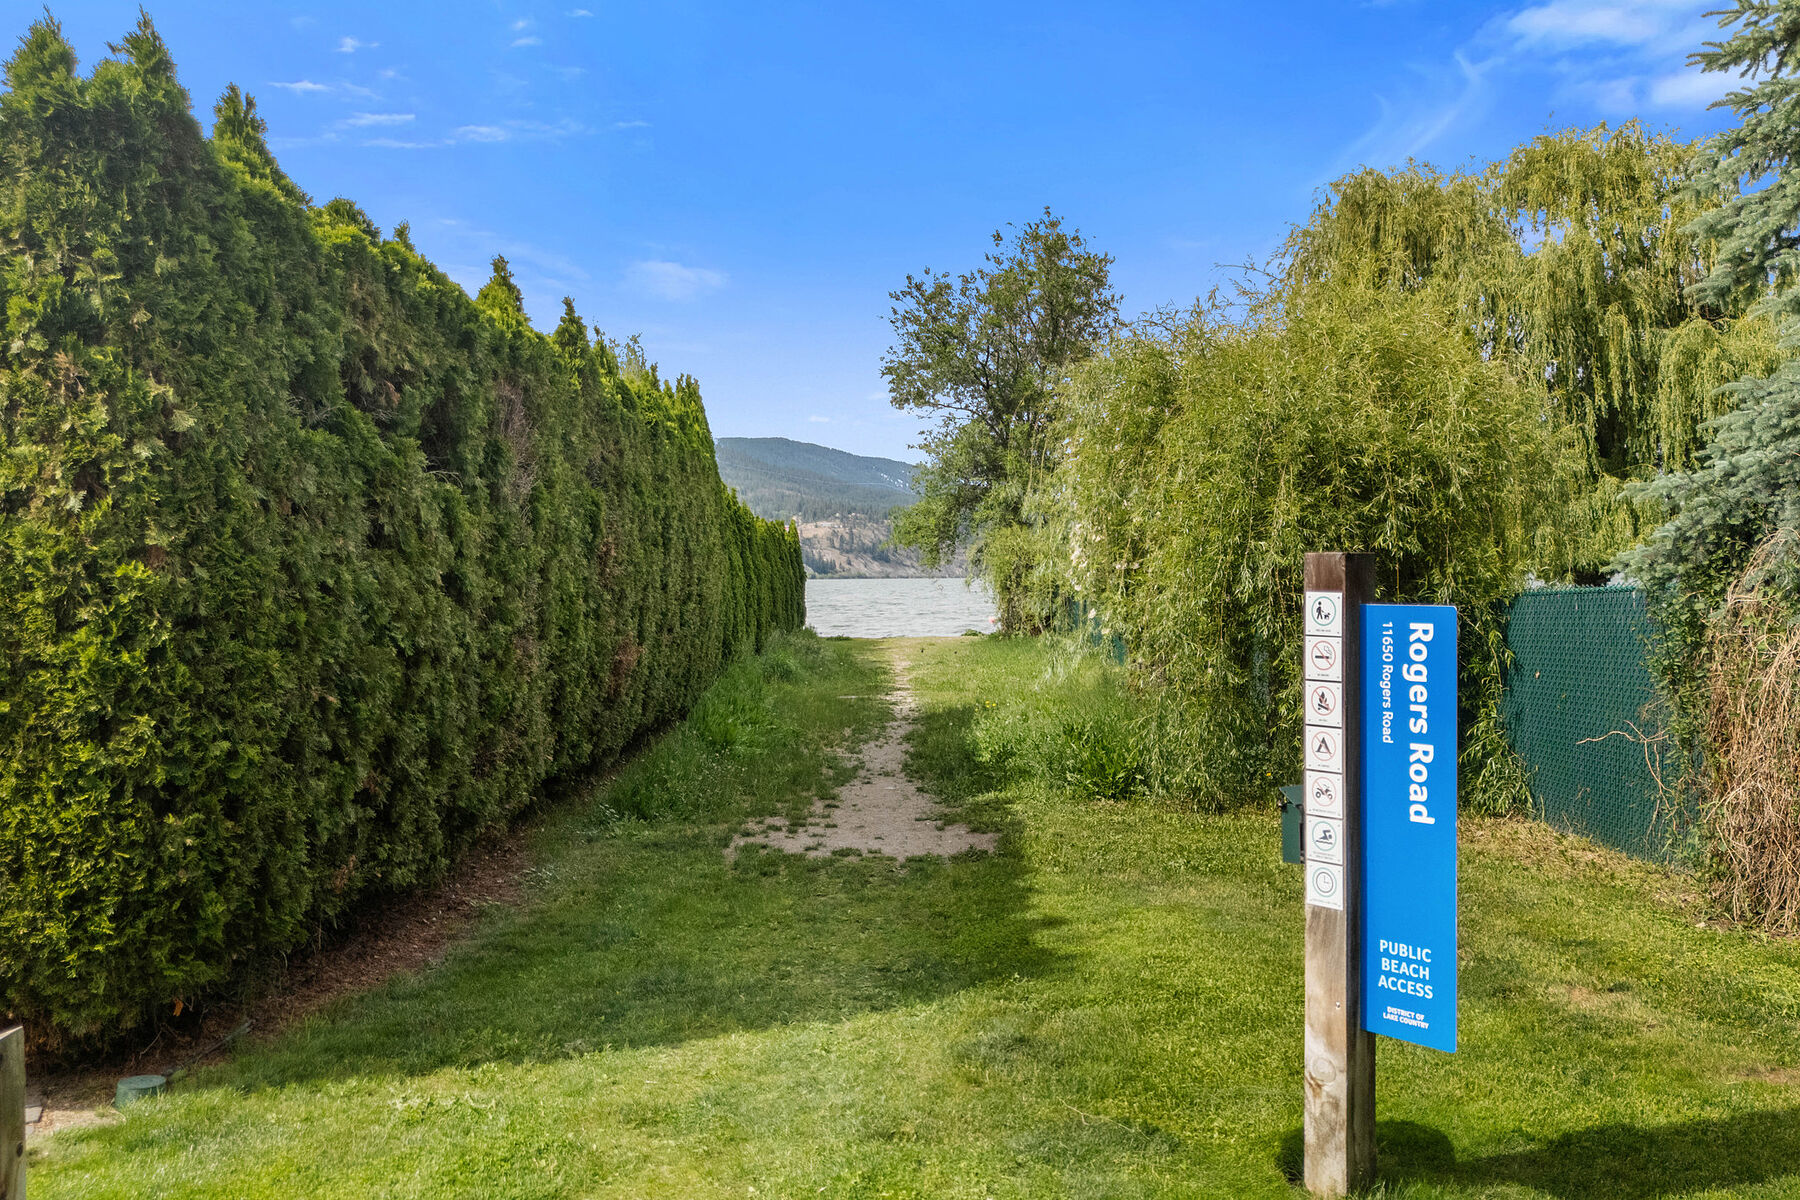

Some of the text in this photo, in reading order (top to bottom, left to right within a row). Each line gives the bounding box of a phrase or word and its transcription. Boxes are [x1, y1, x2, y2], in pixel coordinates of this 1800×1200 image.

[1379, 621, 1394, 744] 11650 Rogers Road
[1402, 622, 1436, 825] Rogers Road
[1379, 939, 1432, 963] PUBLIC
[1381, 957, 1430, 981] BEACH
[1378, 974, 1434, 999] ACCESS
[1382, 1012, 1430, 1029] LAKE COUNTRY
[1386, 1006, 1425, 1021] DISTRICT OF
